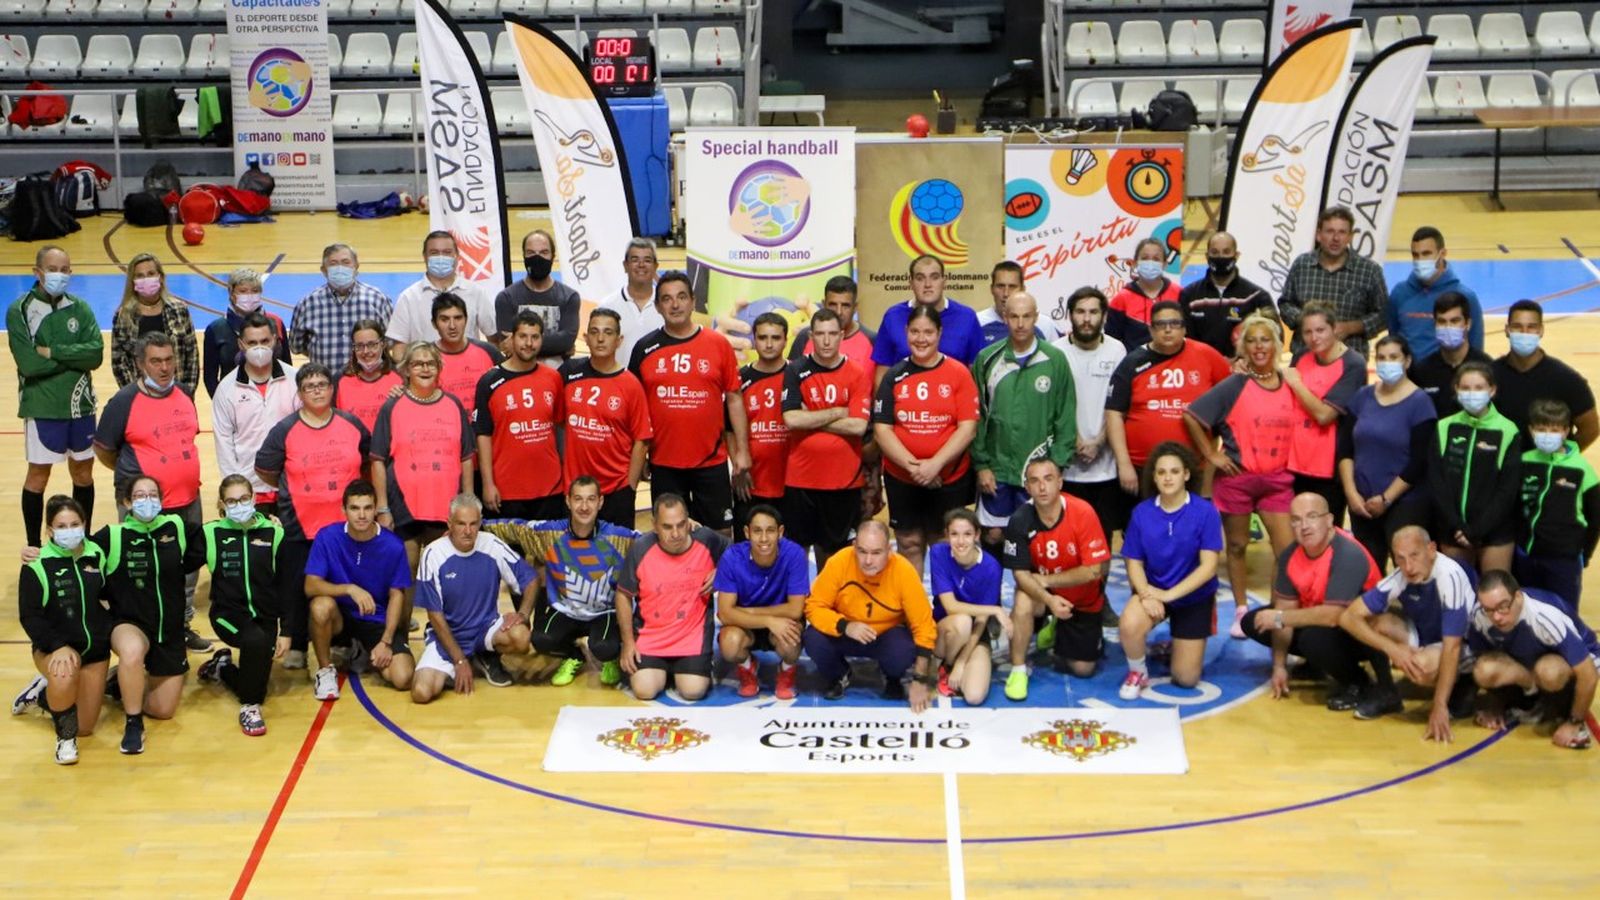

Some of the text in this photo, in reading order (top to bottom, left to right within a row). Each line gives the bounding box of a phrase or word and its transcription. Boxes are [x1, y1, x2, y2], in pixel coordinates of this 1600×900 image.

[235, 14, 244, 22] EL
[247, 14, 288, 22] DEPORTE
[235, 25, 259, 33] OTRA
[591, 57, 614, 65] LOCAL
[702, 139, 838, 158] Special handball
[1016, 226, 1064, 244] ESE ES EL
[671, 353, 691, 374] 15
[1161, 368, 1184, 388] 20
[522, 388, 534, 409] 5
[586, 385, 601, 406] 2
[764, 388, 775, 408] 3
[825, 383, 838, 404] 0
[916, 381, 929, 400] 6
[1046, 540, 1059, 559] 8
[866, 602, 873, 618] 1
[763, 719, 970, 730] Ajuntament de
[759, 731, 971, 749] Castelló
[808, 751, 915, 763] Esports
